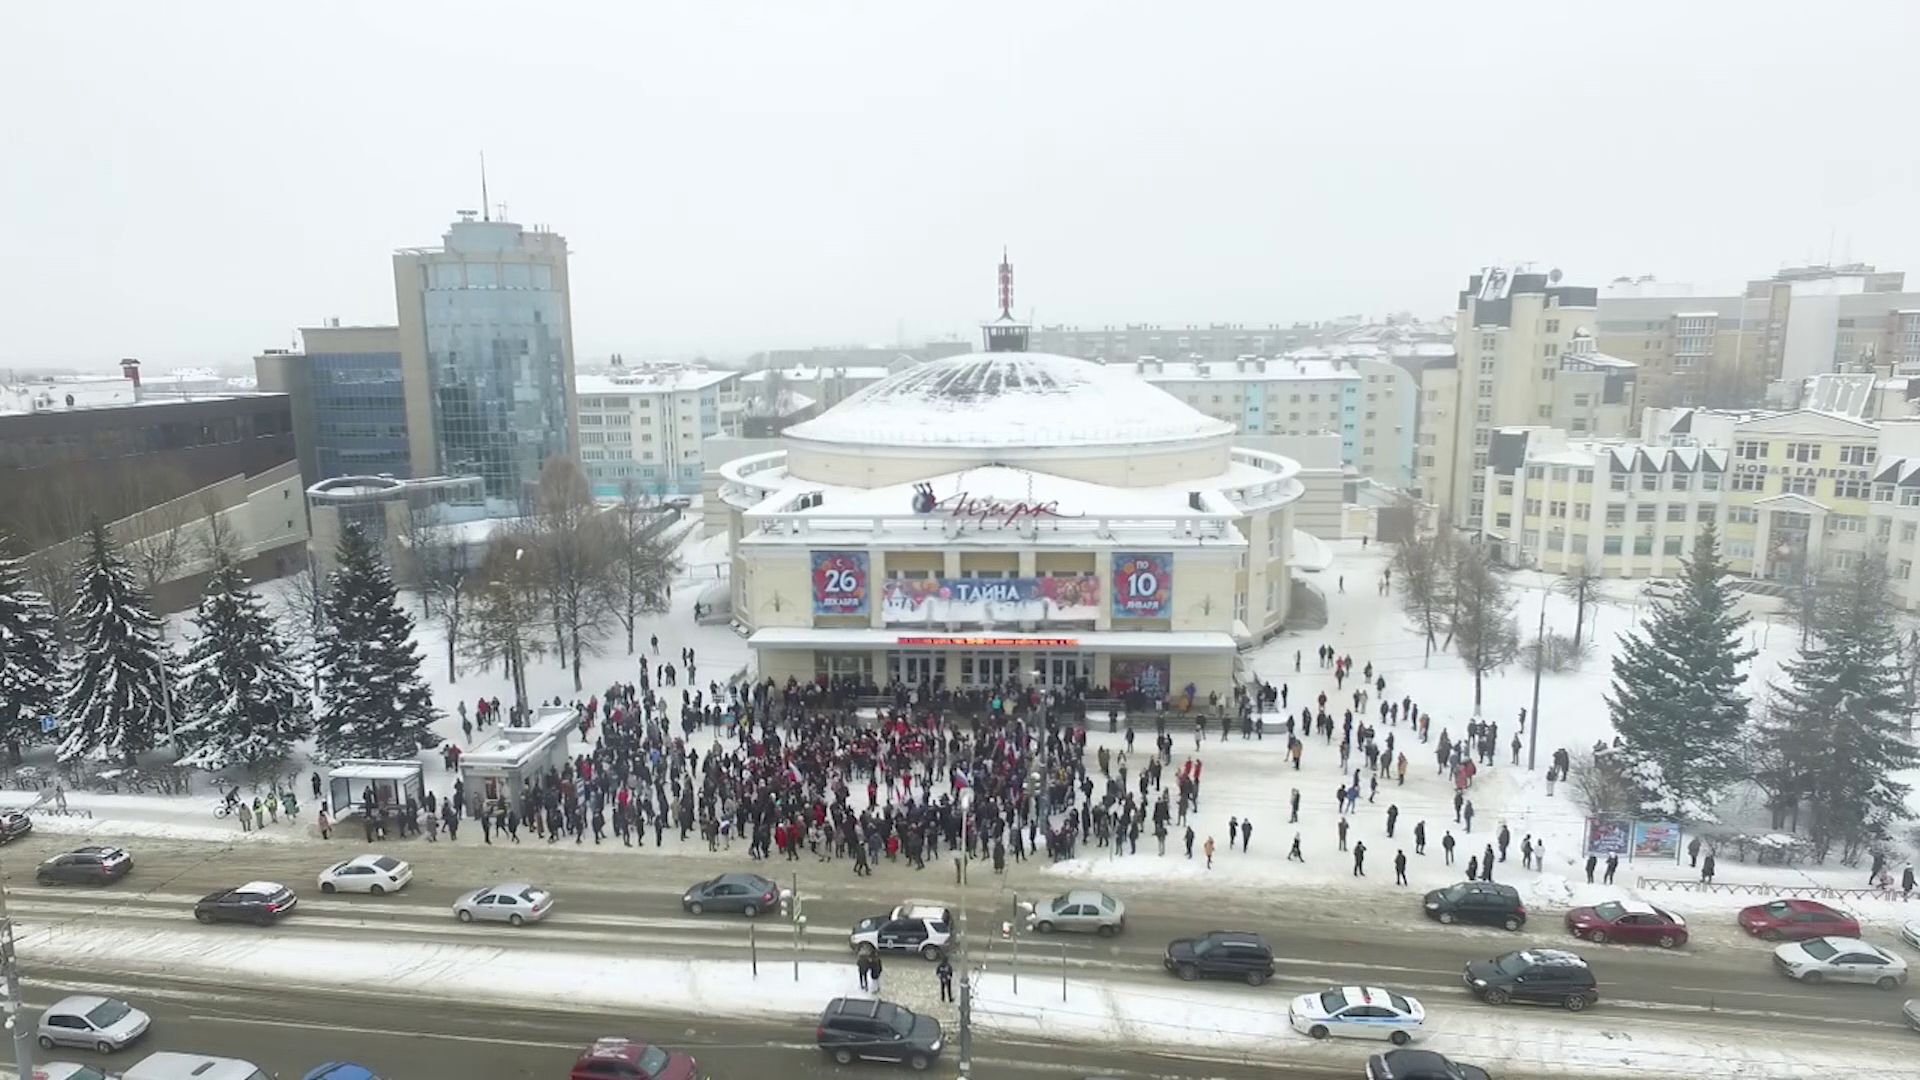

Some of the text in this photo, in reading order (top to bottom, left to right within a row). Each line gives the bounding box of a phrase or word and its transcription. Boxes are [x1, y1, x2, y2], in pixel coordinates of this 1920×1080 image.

[1735, 463, 1868, 480] НОВАЯ ГАЛЕРЕЯ
[825, 570, 857, 592] 26
[1128, 572, 1157, 597] 10
[956, 584, 1020, 601] ТАЙНА
